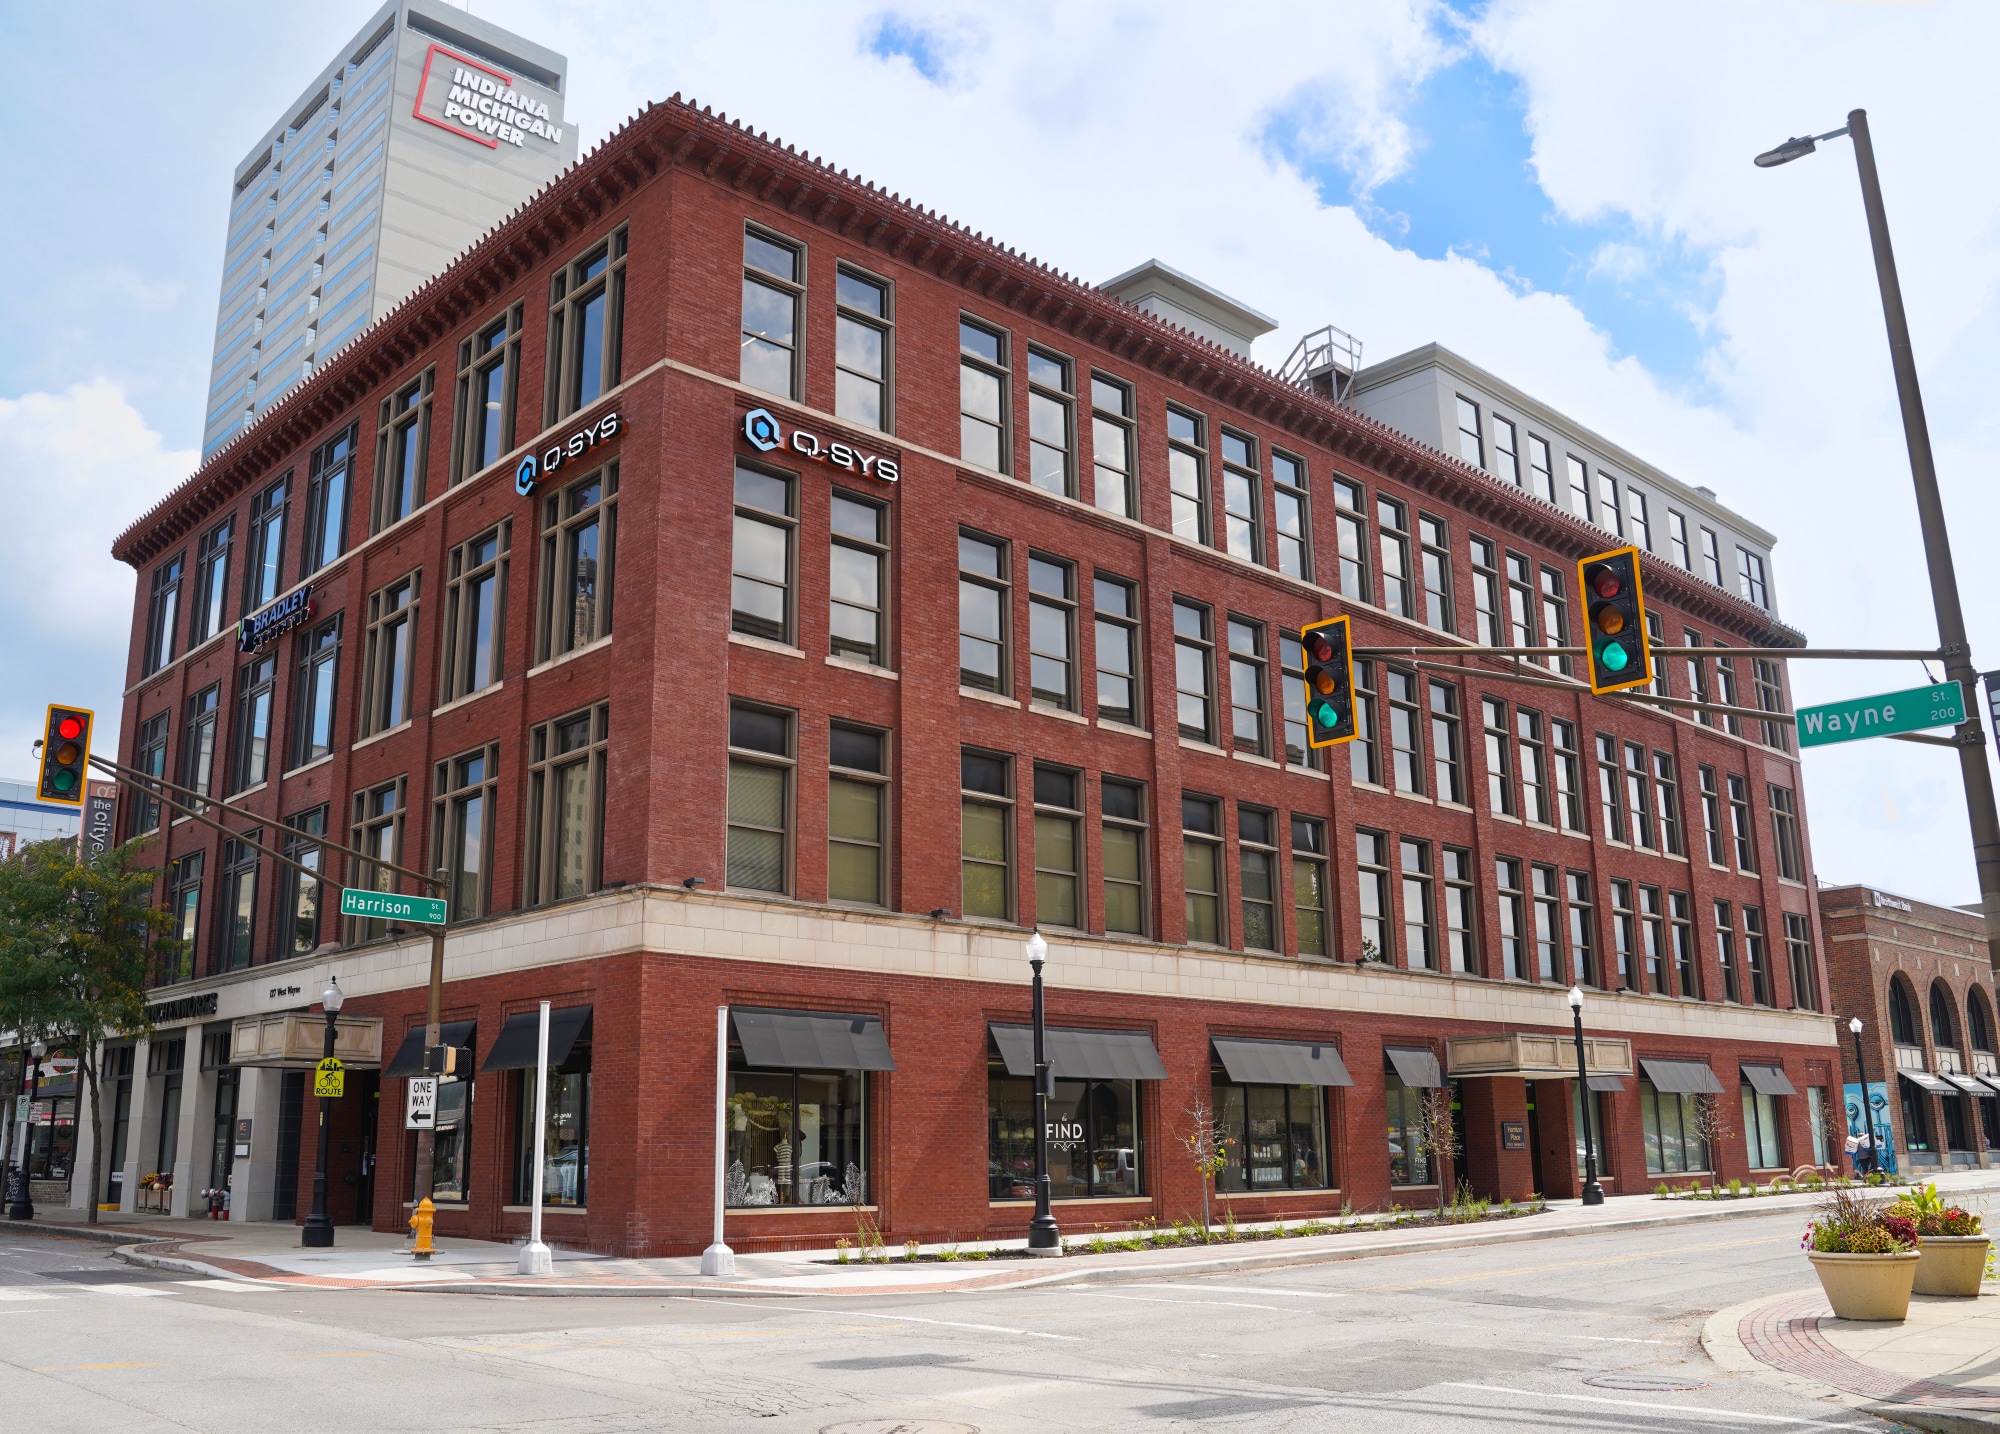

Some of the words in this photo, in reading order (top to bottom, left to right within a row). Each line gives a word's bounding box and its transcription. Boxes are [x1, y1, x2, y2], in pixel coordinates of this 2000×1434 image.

[453, 67, 550, 121] INDIANA
[444, 101, 525, 147] POWER
[448, 85, 563, 144] MICHIGAN
[543, 412, 617, 472] Q-SYS
[792, 430, 899, 482] Q-SYS
[254, 586, 307, 634] BRADLEY
[1804, 705, 1896, 735] Wayne
[1930, 707, 1956, 721] 200
[93, 799, 111, 811] the
[346, 895, 411, 915] Harrison
[1881, 895, 1902, 910] Northwest
[1901, 900, 1912, 912] Bank
[316, 1087, 342, 1096] ROUTE
[413, 1081, 432, 1094] ONE
[412, 1095, 432, 1107] WAY
[1046, 1123, 1083, 1139] FIND
